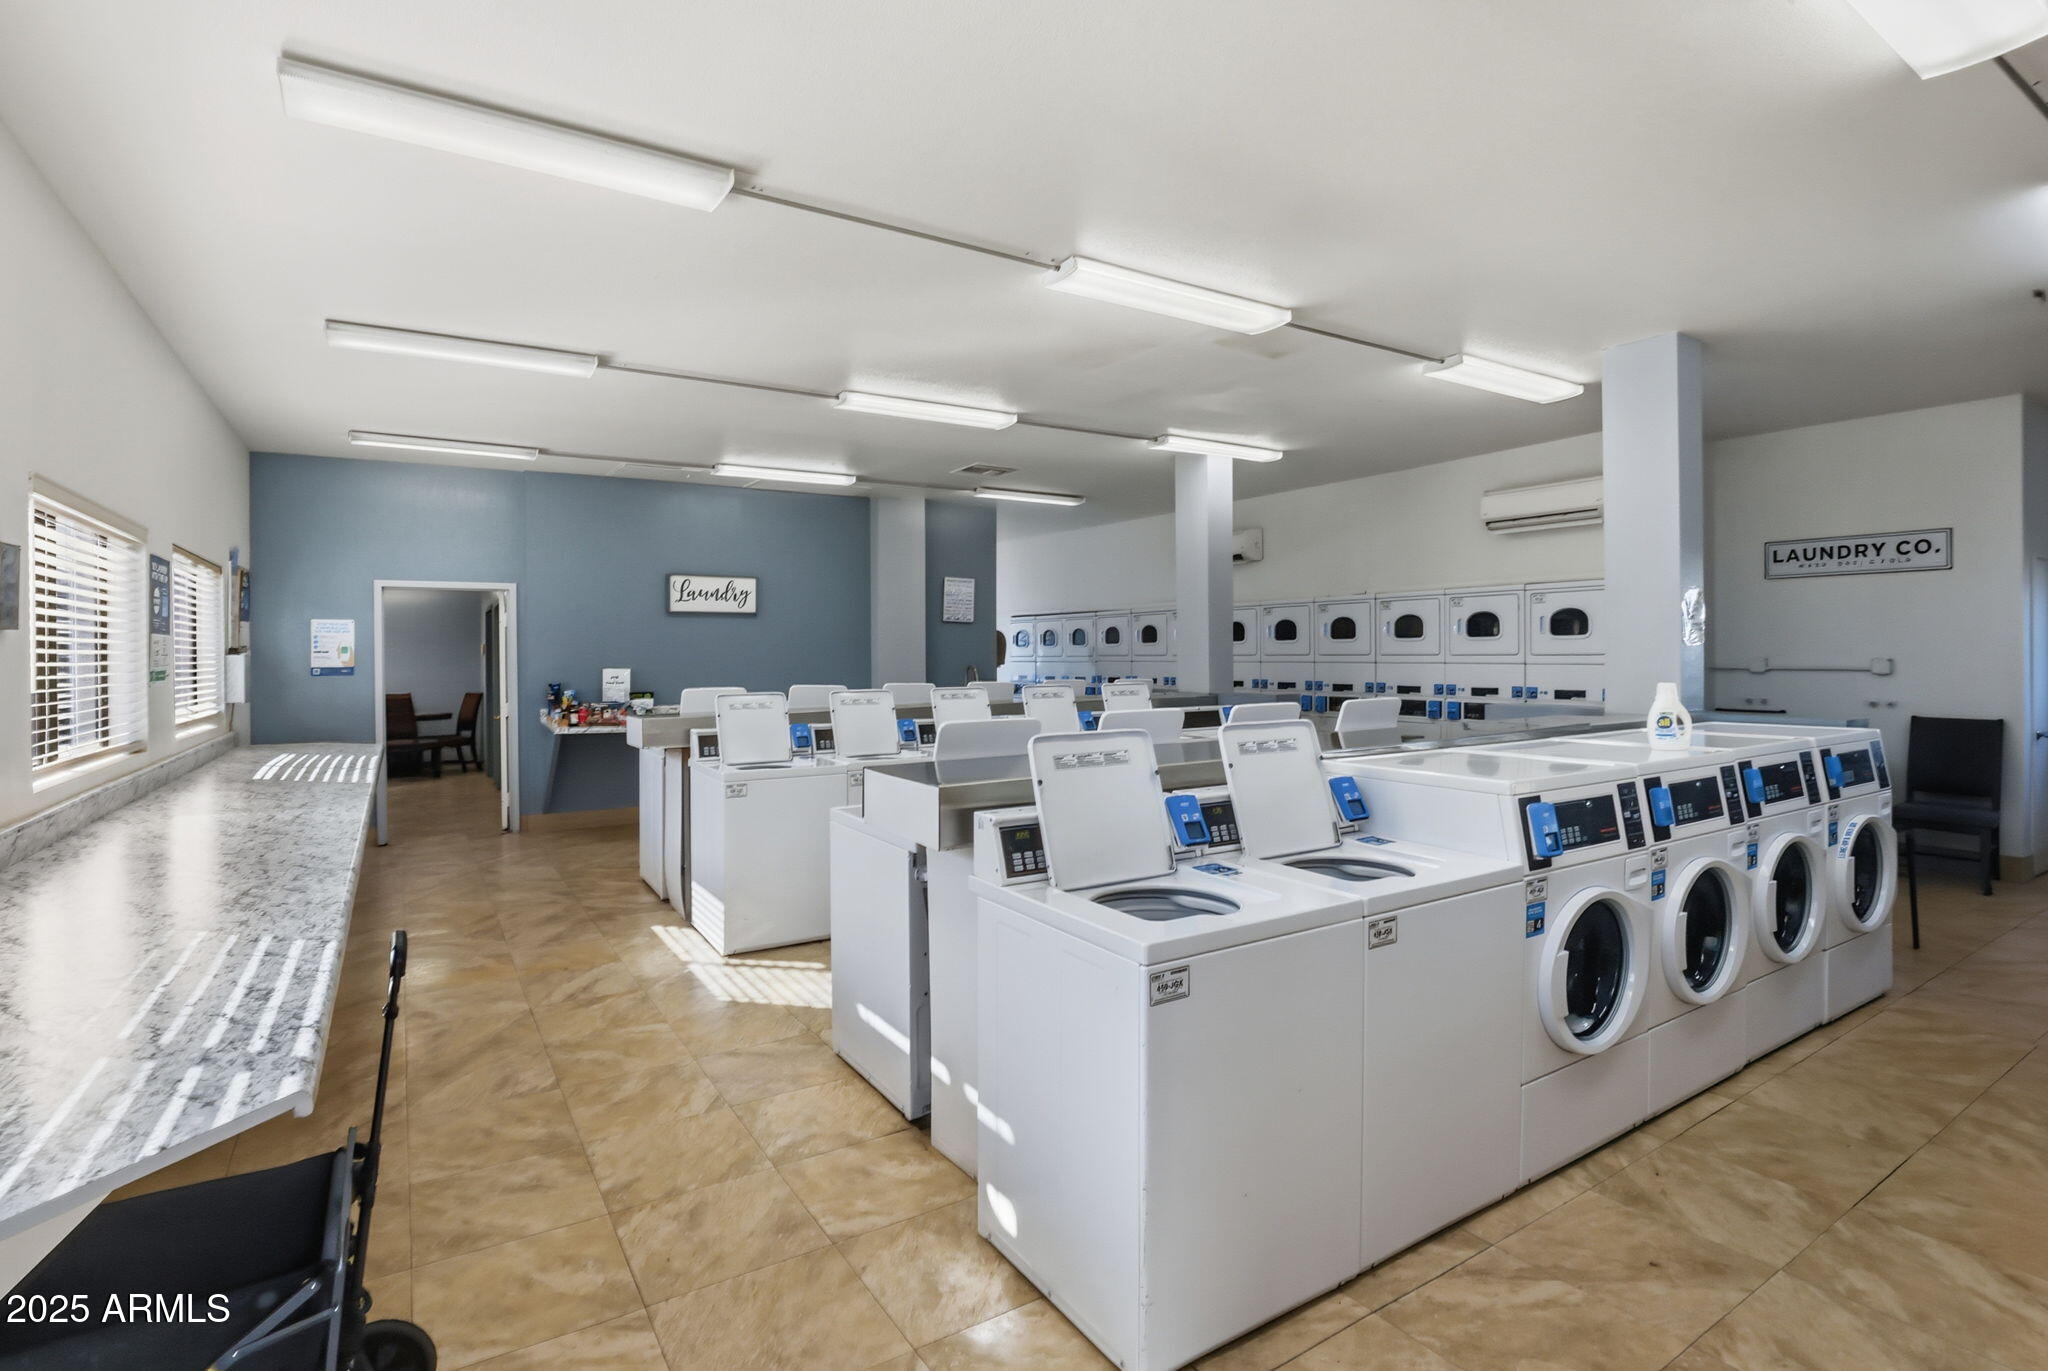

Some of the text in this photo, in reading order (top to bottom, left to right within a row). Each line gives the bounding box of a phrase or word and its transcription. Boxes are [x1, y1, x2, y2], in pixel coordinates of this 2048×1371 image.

[1772, 542, 1886, 563] LAUNDRY
[1895, 539, 1942, 556] CO.
[673, 578, 752, 609] Laundry
